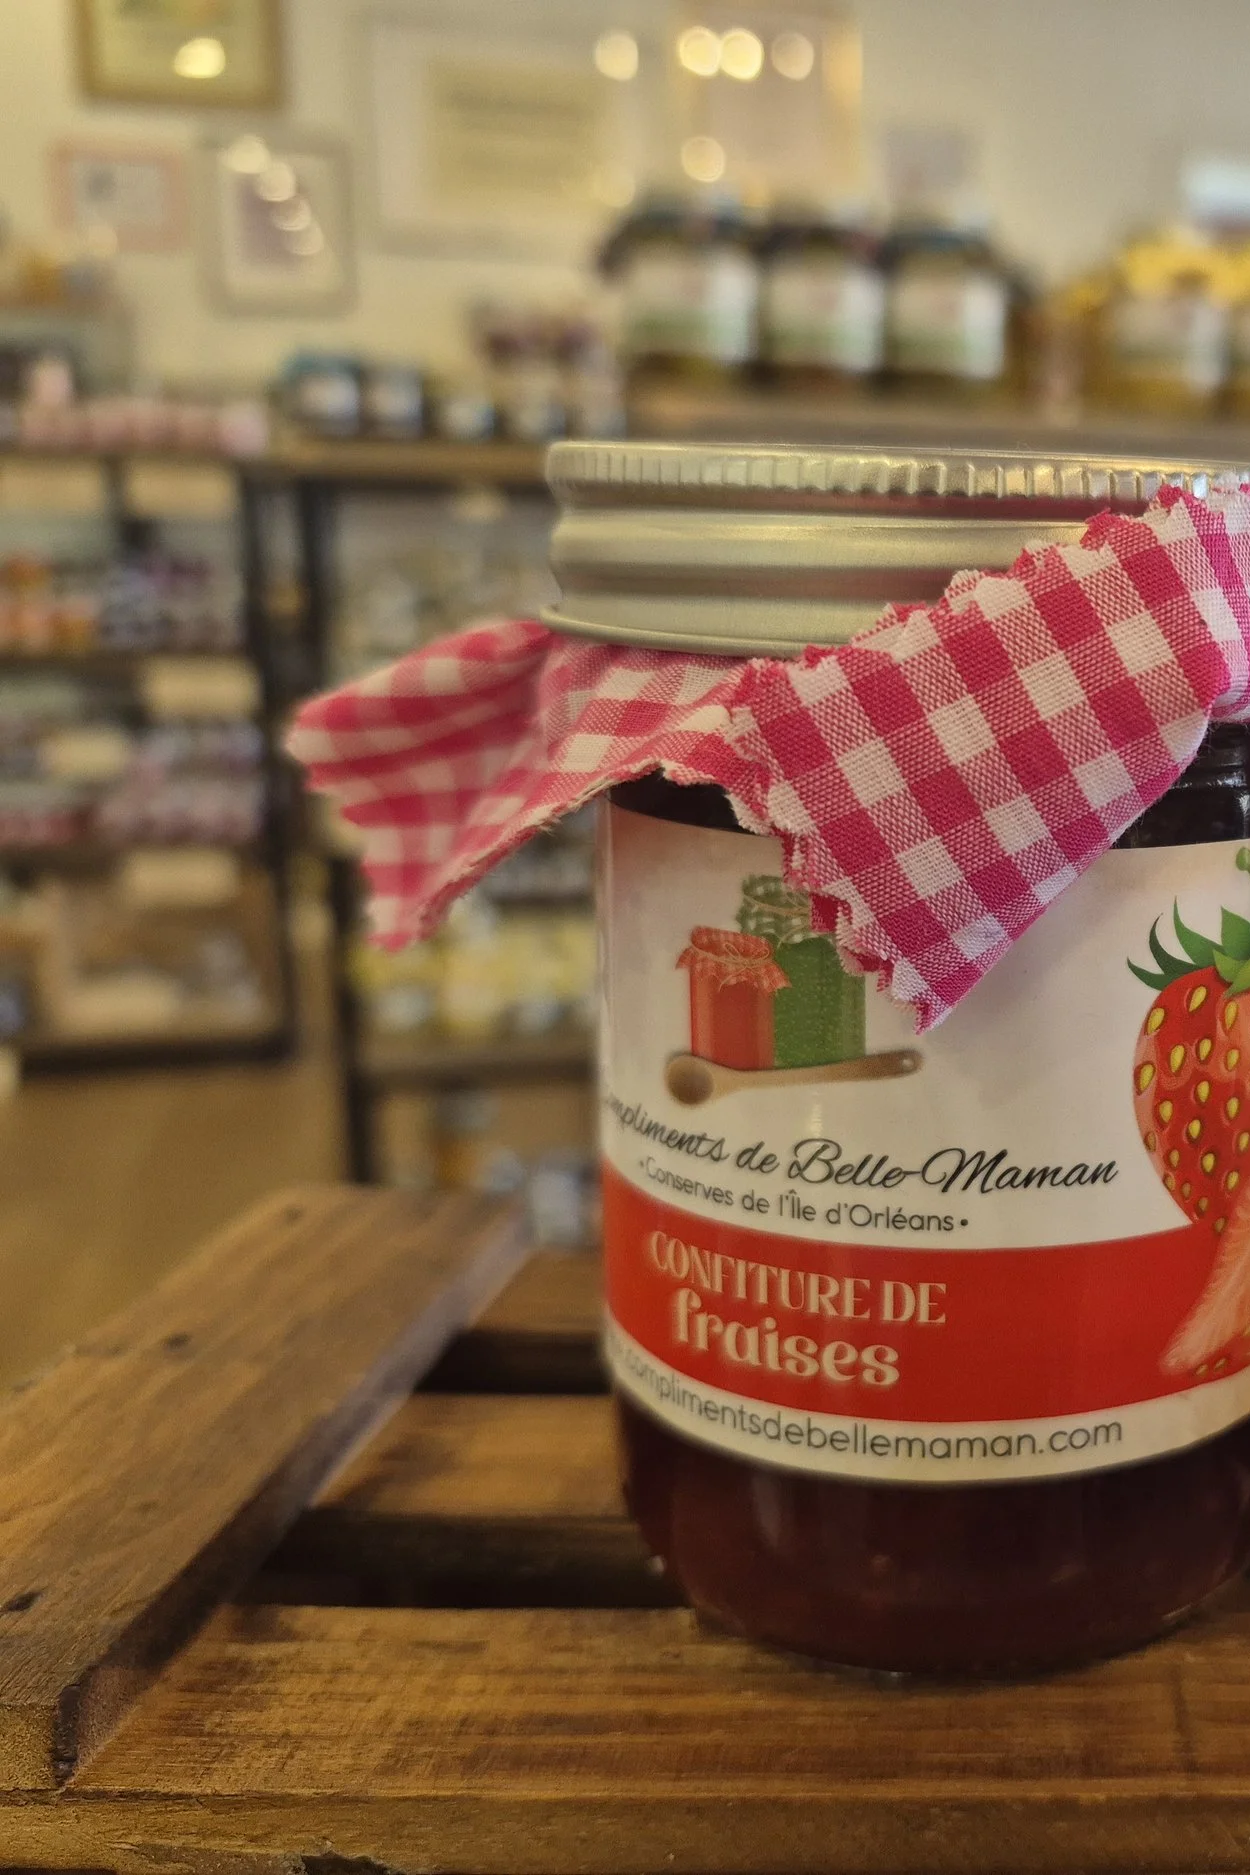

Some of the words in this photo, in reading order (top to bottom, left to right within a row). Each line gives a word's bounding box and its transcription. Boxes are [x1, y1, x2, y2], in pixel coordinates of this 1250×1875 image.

[604, 1091, 730, 1162] mpliments
[735, 1140, 780, 1174] de
[787, 1137, 1119, 1195] Belle-Maman
[741, 1191, 770, 1214] de
[779, 1188, 817, 1221] l'Île
[650, 1230, 871, 1320] CONFITURE
[882, 1279, 947, 1324] DE
[673, 1287, 901, 1386] fraises
